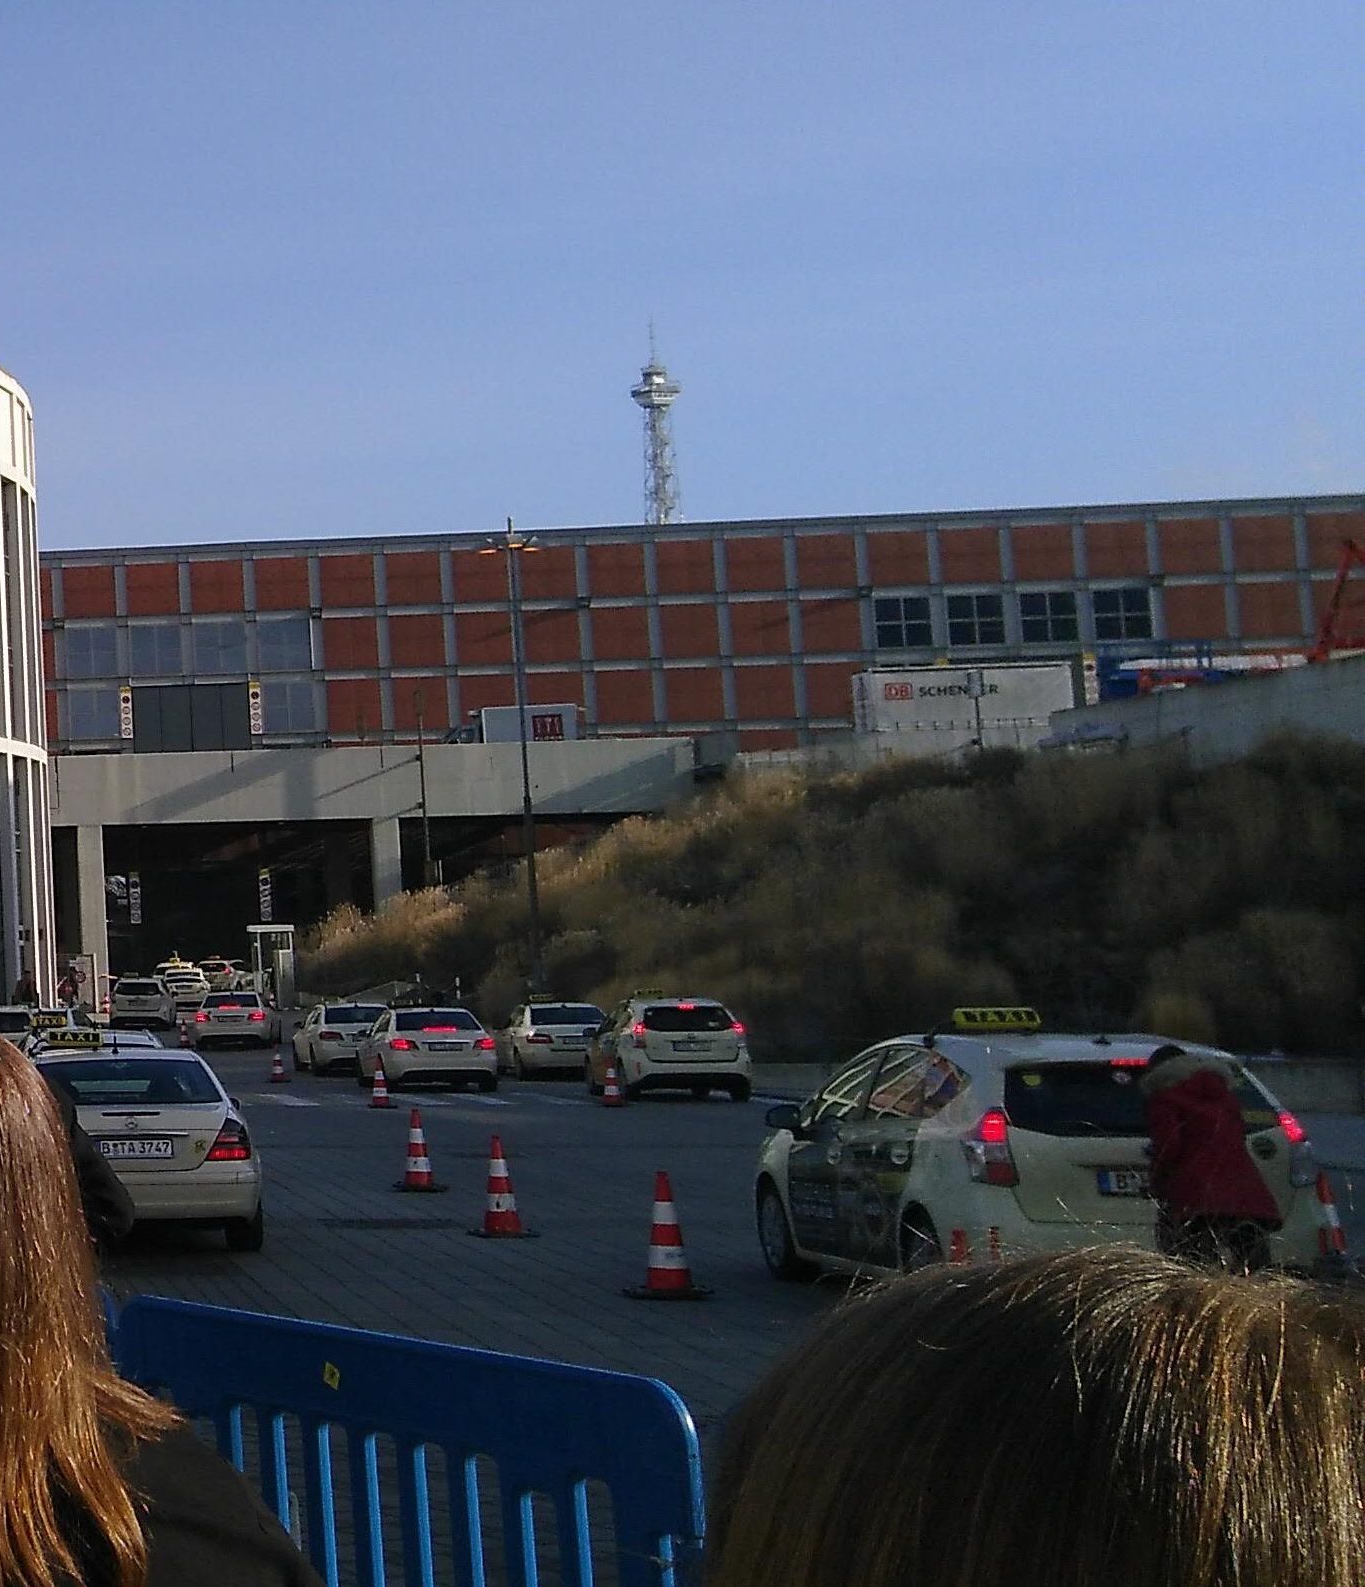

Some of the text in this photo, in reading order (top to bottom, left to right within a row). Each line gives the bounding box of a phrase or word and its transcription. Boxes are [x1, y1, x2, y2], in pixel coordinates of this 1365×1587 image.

[886, 684, 999, 699] DB SCHENR
[37, 1018, 61, 1026] TAXI
[55, 1032, 95, 1042] TAXI
[101, 1142, 110, 1155] B
[140, 1141, 170, 1154] 3747
